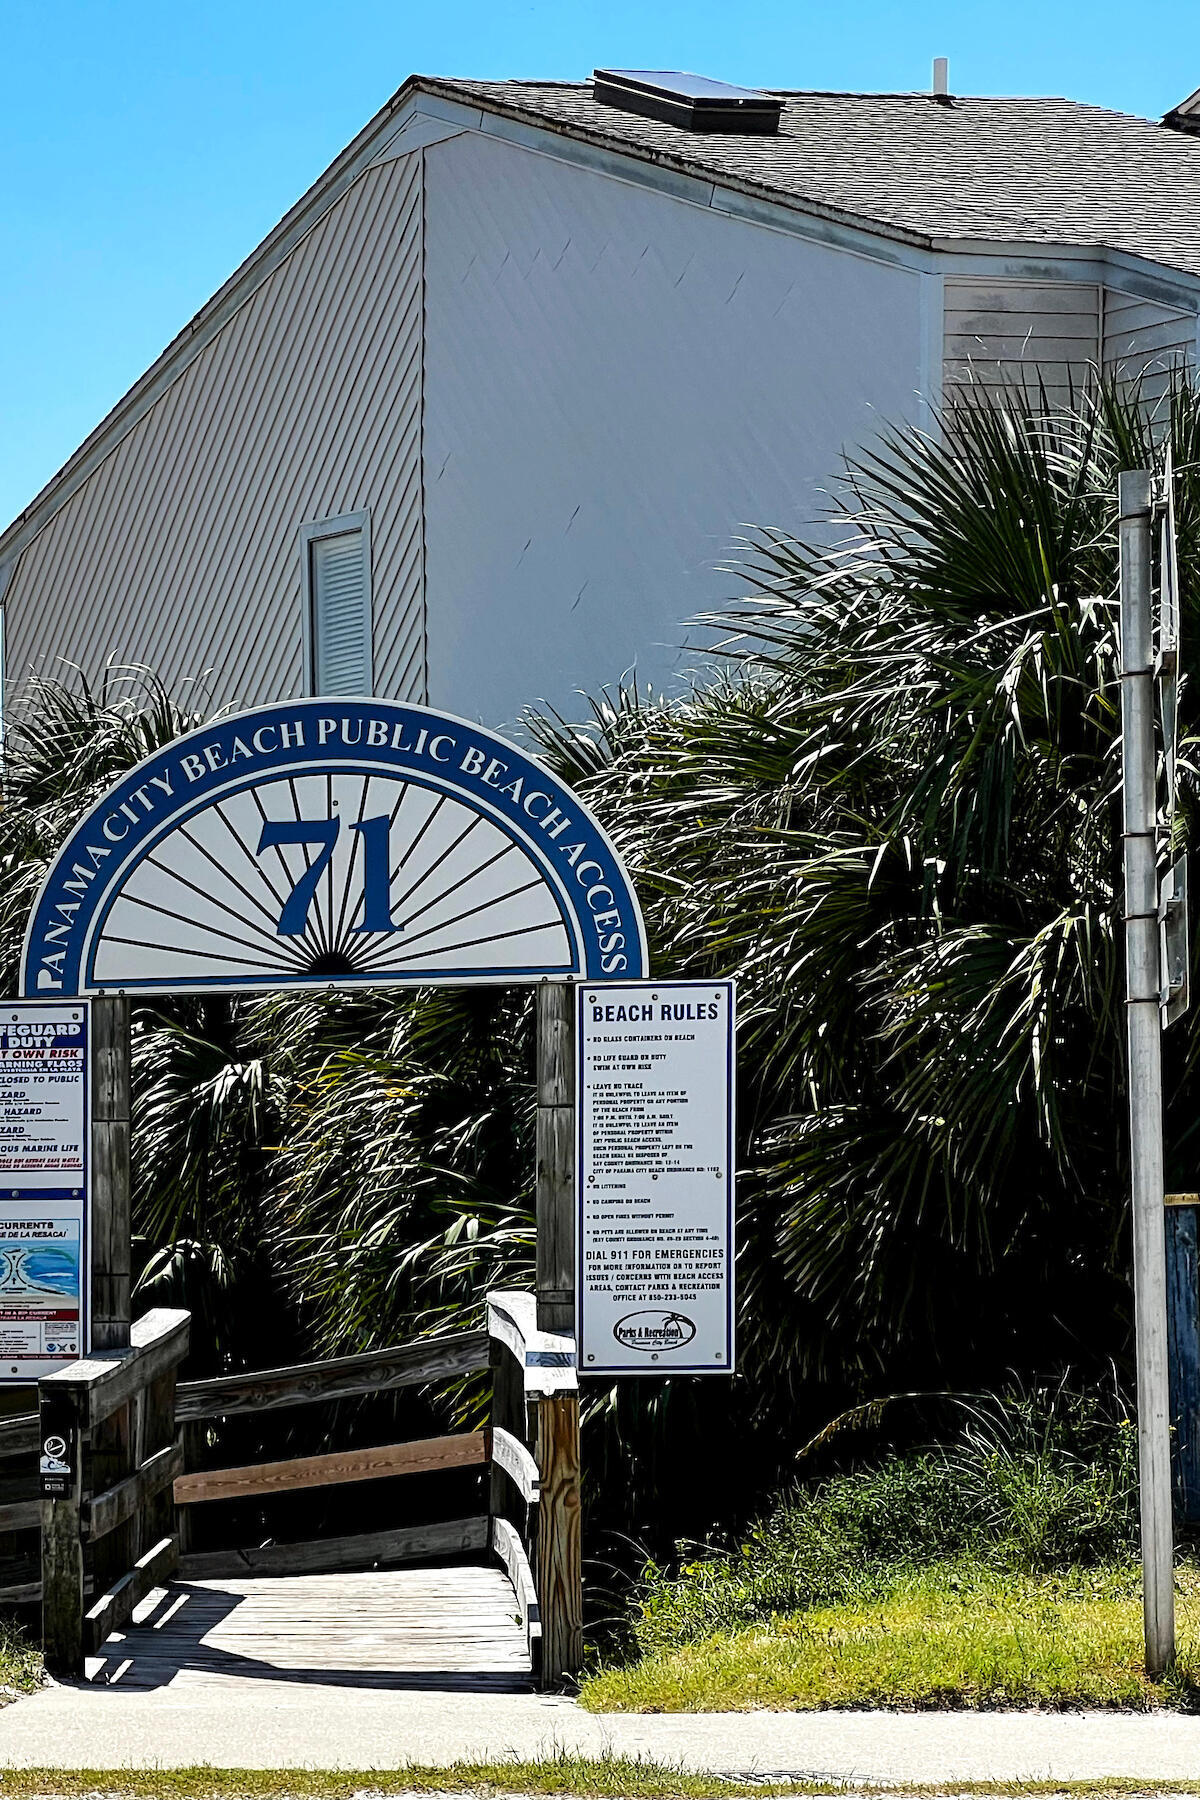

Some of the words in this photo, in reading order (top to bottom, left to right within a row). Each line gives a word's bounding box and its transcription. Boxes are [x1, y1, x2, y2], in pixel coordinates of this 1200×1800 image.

[37, 845, 112, 990] PANAMA
[103, 769, 175, 843] CITY
[181, 720, 304, 783] BEACH
[318, 719, 457, 762] PUBLIC
[460, 746, 572, 840] BEACH
[558, 842, 629, 973] ACCESS
[256, 814, 404, 936] 71
[593, 1005, 653, 1022] BEACH
[661, 1003, 718, 1021] RULES
[8, 1036, 55, 1048] DUTY
[13, 1050, 44, 1059] OWN
[50, 1050, 78, 1058] RISK
[586, 1251, 607, 1260] DIAL
[611, 1250, 628, 1259] 911
[633, 1250, 651, 1259] FOR
[655, 1249, 723, 1259] EMERGENCIES
[619, 1328, 636, 1338] Parks
[644, 1327, 678, 1338] Recreation
